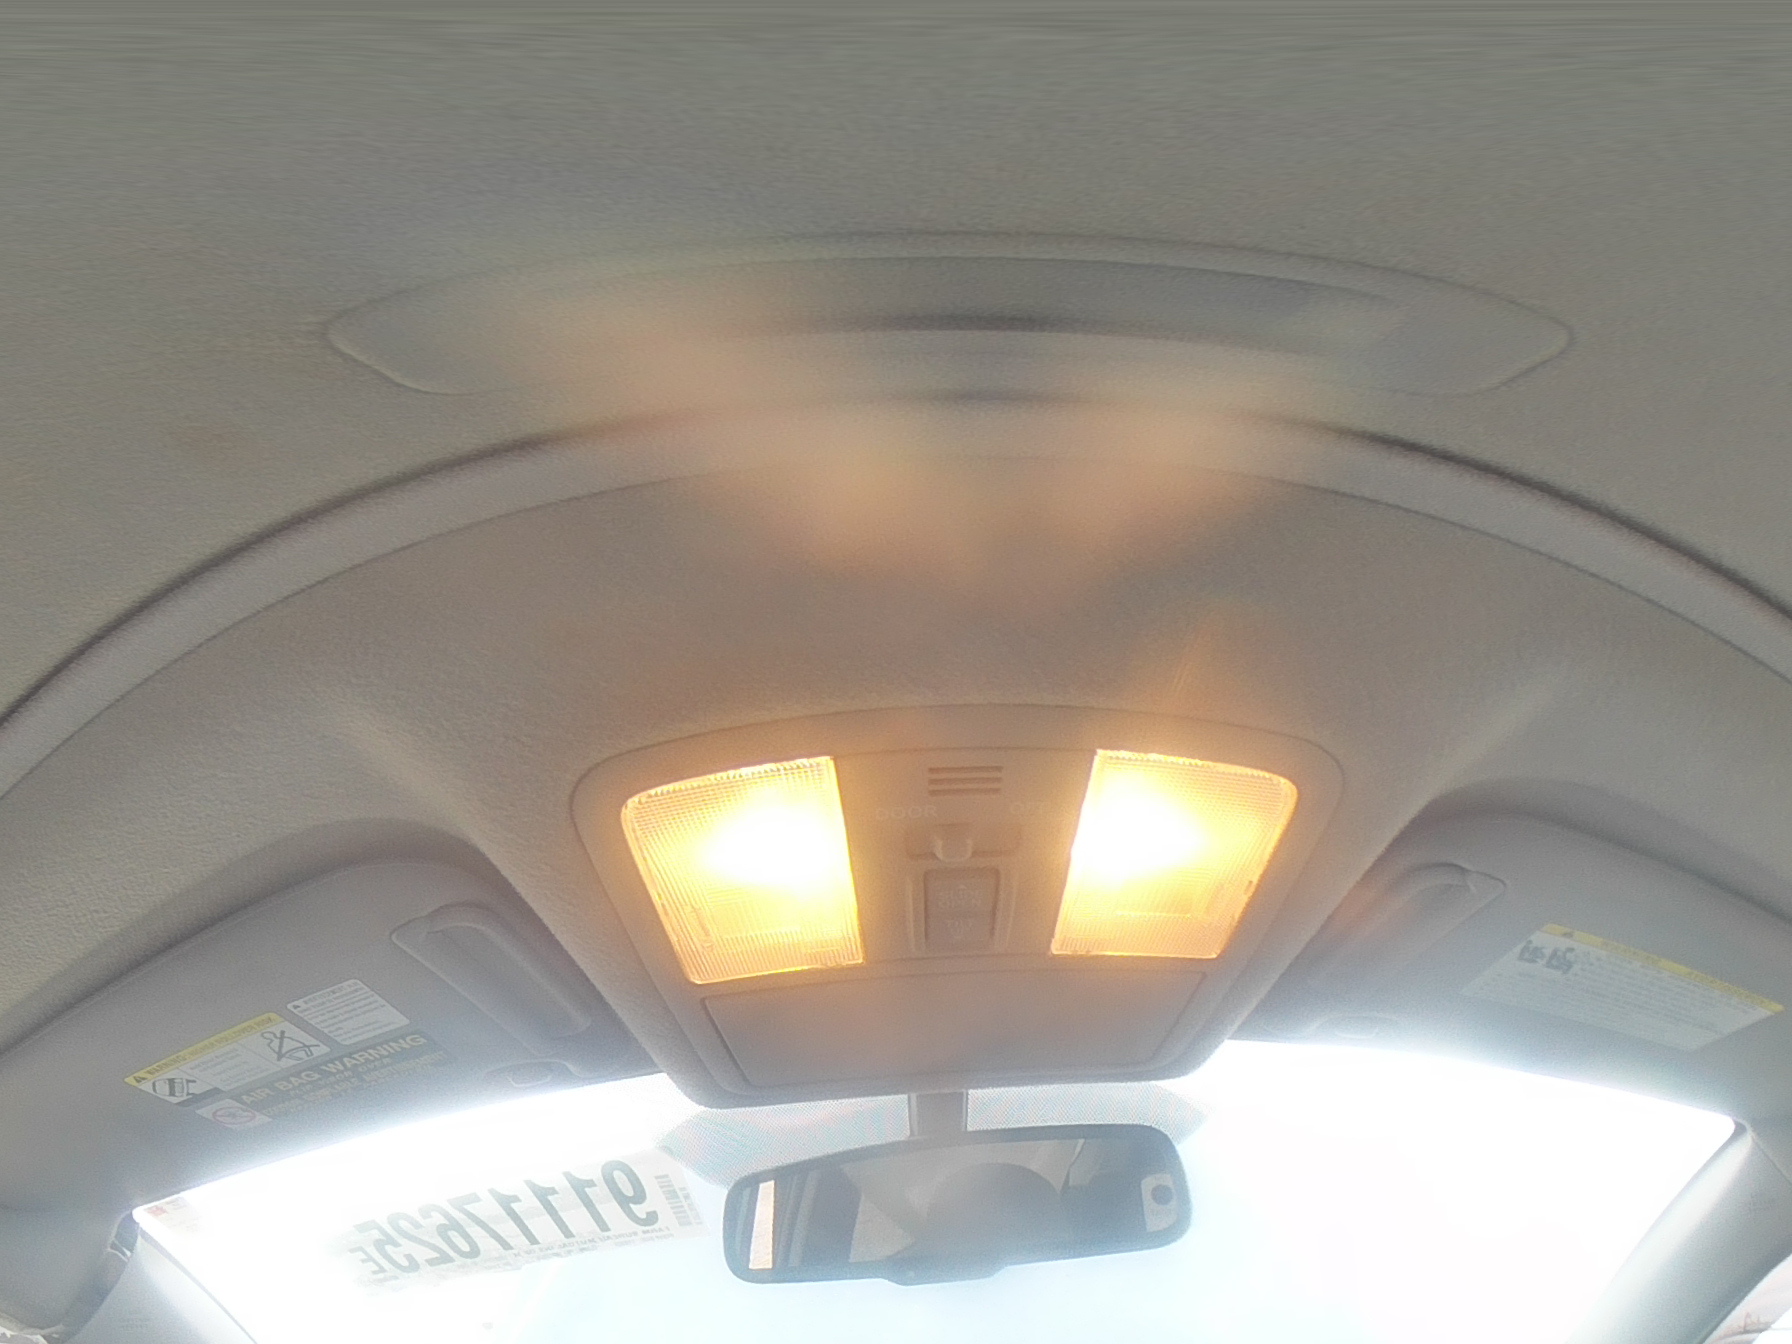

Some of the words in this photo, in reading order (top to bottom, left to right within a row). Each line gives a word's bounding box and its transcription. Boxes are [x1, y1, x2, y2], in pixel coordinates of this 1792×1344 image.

[875, 804, 938, 820] DOOR
[241, 1087, 272, 1105] AIR
[274, 1070, 321, 1091] BAG
[323, 1033, 428, 1073] WARNING
